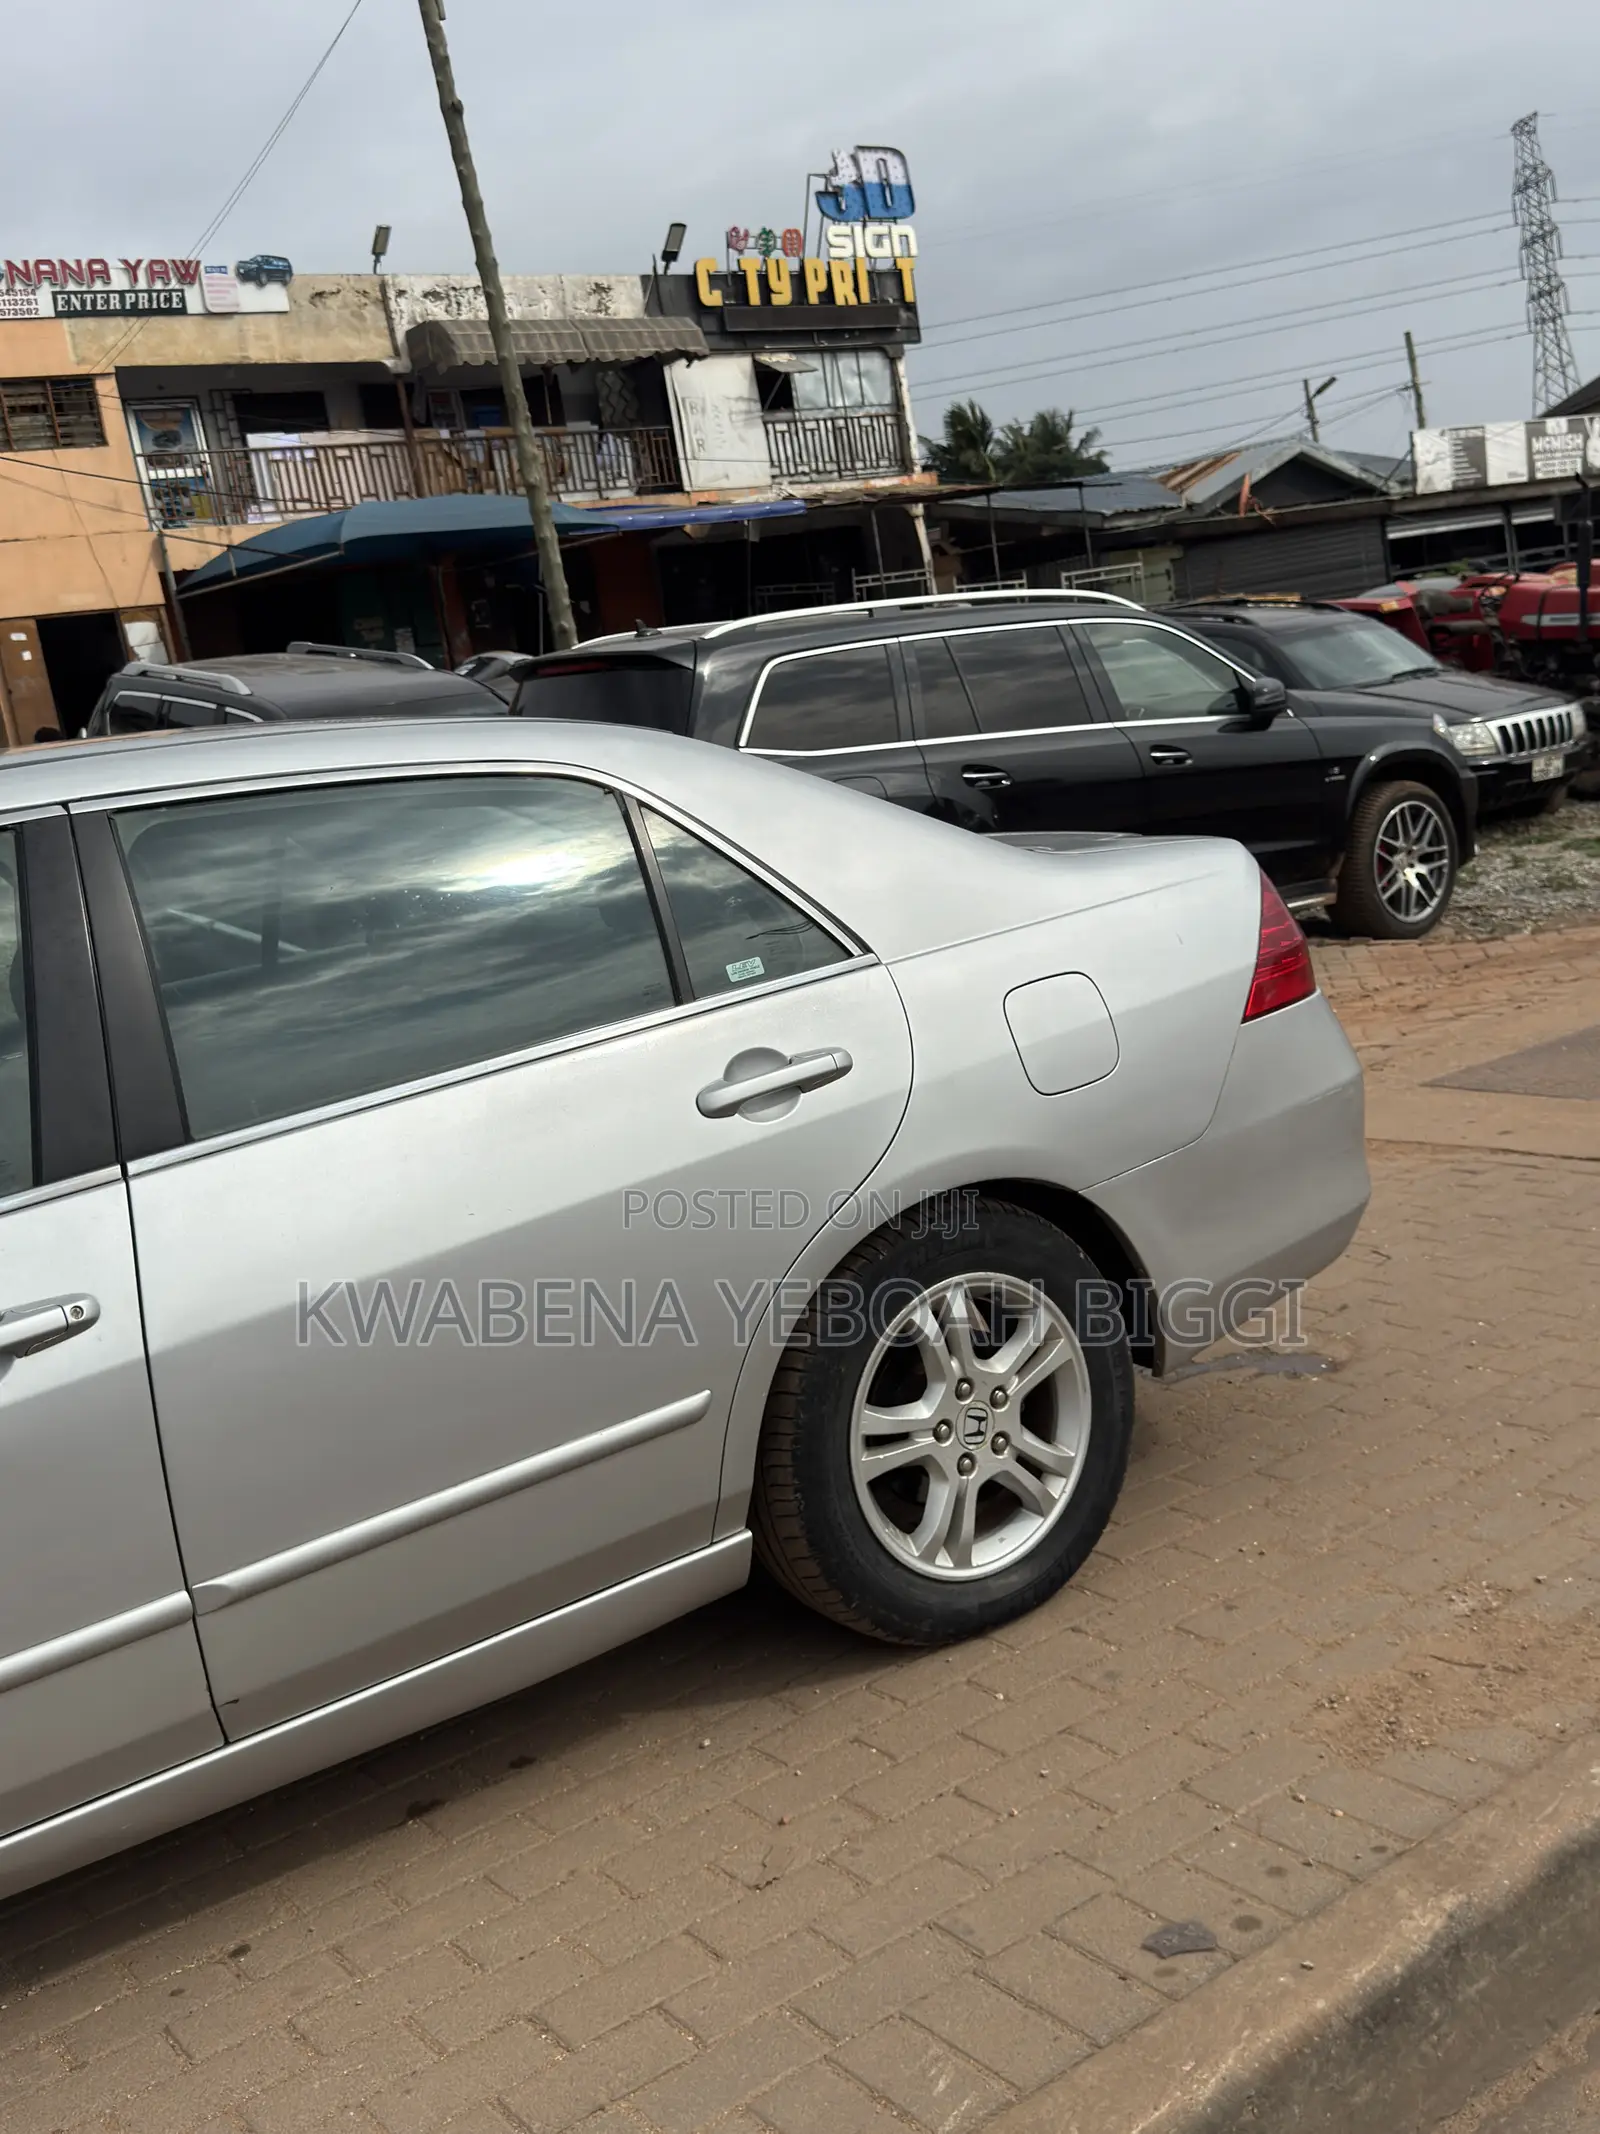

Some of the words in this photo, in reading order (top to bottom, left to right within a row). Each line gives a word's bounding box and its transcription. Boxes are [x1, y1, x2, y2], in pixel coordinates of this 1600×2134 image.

[4, 258, 111, 288] NANA
[118, 258, 202, 288] YAW
[696, 258, 793, 306] CTY
[803, 258, 916, 306] PRIT
[0, 298, 39, 307] 113261
